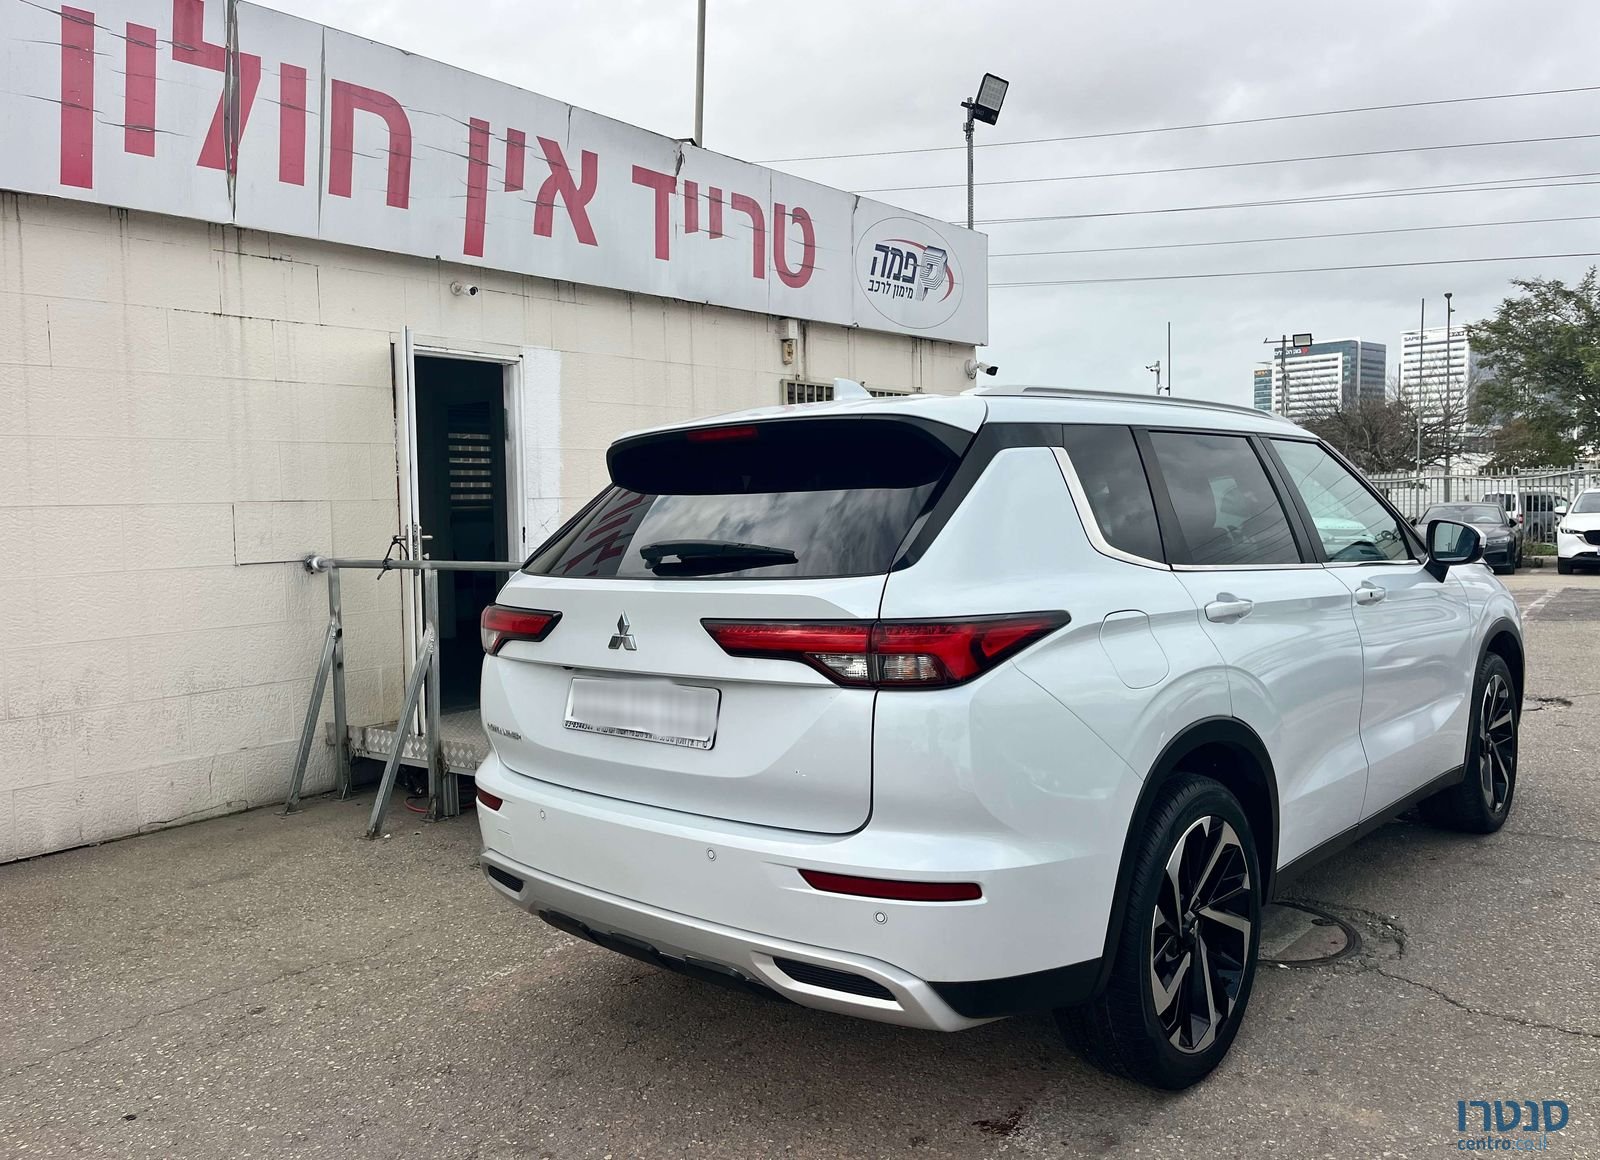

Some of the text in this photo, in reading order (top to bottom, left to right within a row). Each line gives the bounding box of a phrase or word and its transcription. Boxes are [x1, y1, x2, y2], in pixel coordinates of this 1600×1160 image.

[60, 0, 816, 289] טרייד אין חולון
[870, 244, 918, 284] פמה
[867, 279, 914, 299] מימון לרכב
